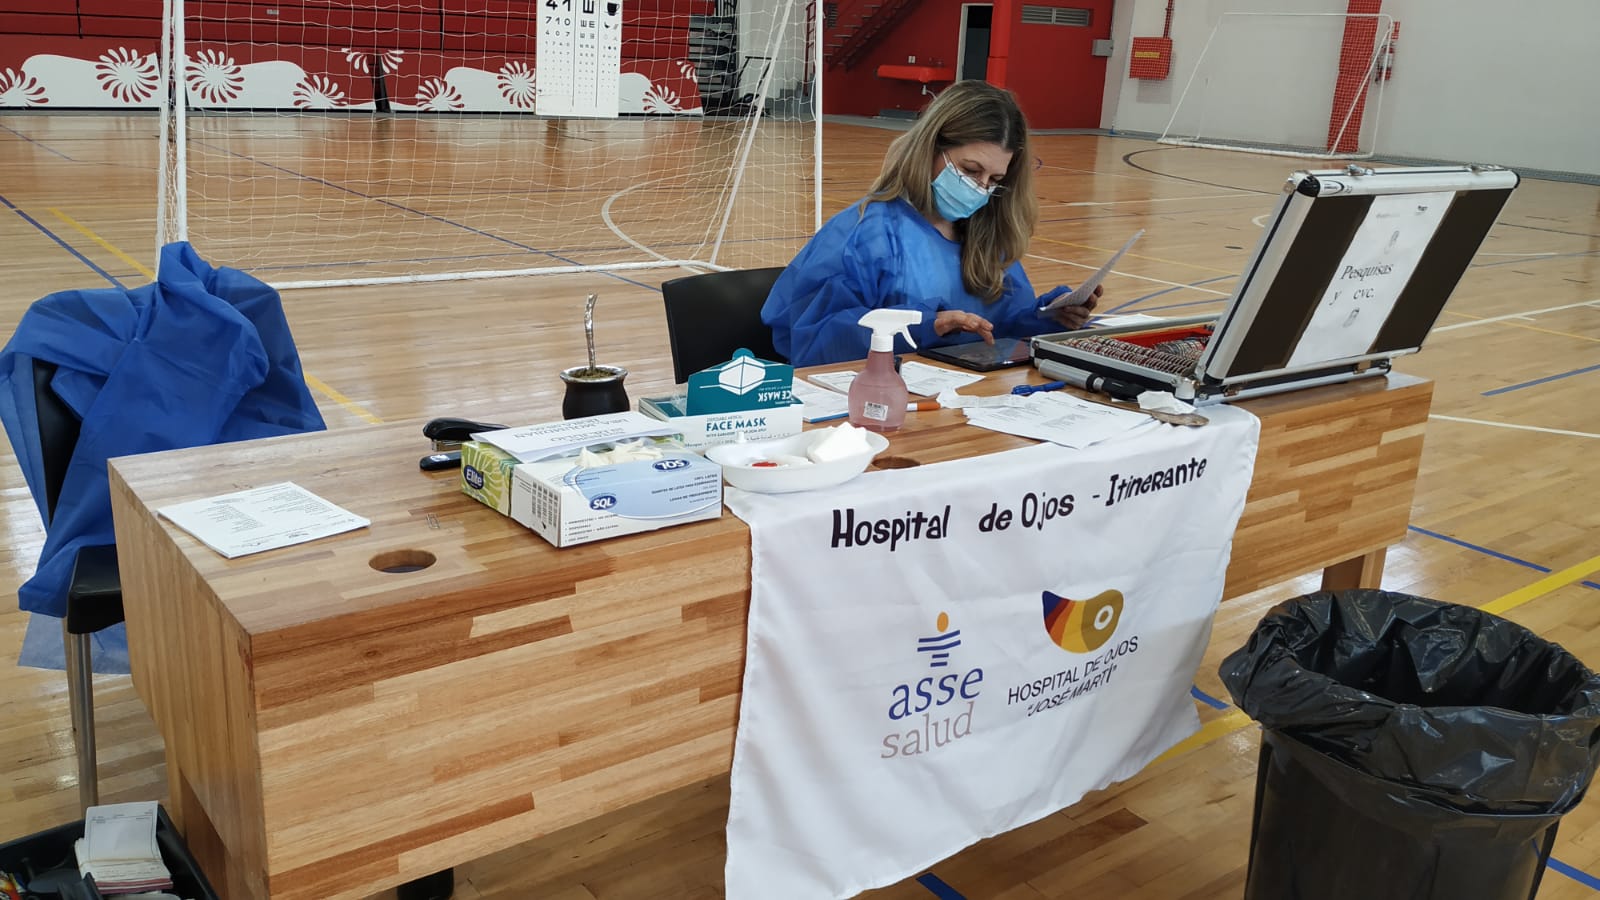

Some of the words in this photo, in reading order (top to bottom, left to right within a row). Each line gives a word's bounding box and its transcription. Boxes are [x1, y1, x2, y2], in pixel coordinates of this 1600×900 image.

[1340, 262, 1394, 281] Pesquisas
[706, 421, 732, 432] FACE
[735, 417, 767, 429] MASK
[466, 469, 482, 486] Elite
[593, 498, 613, 509] SQL
[831, 505, 951, 552] Hospital
[978, 503, 1013, 533] de
[1021, 492, 1075, 531] Ojos
[1106, 457, 1208, 507] Itinerante
[1007, 666, 1080, 706] HOSPITAL
[1083, 654, 1101, 679] DE
[1103, 635, 1139, 666] OJOS
[888, 667, 984, 721] asse
[880, 701, 975, 760] salud
